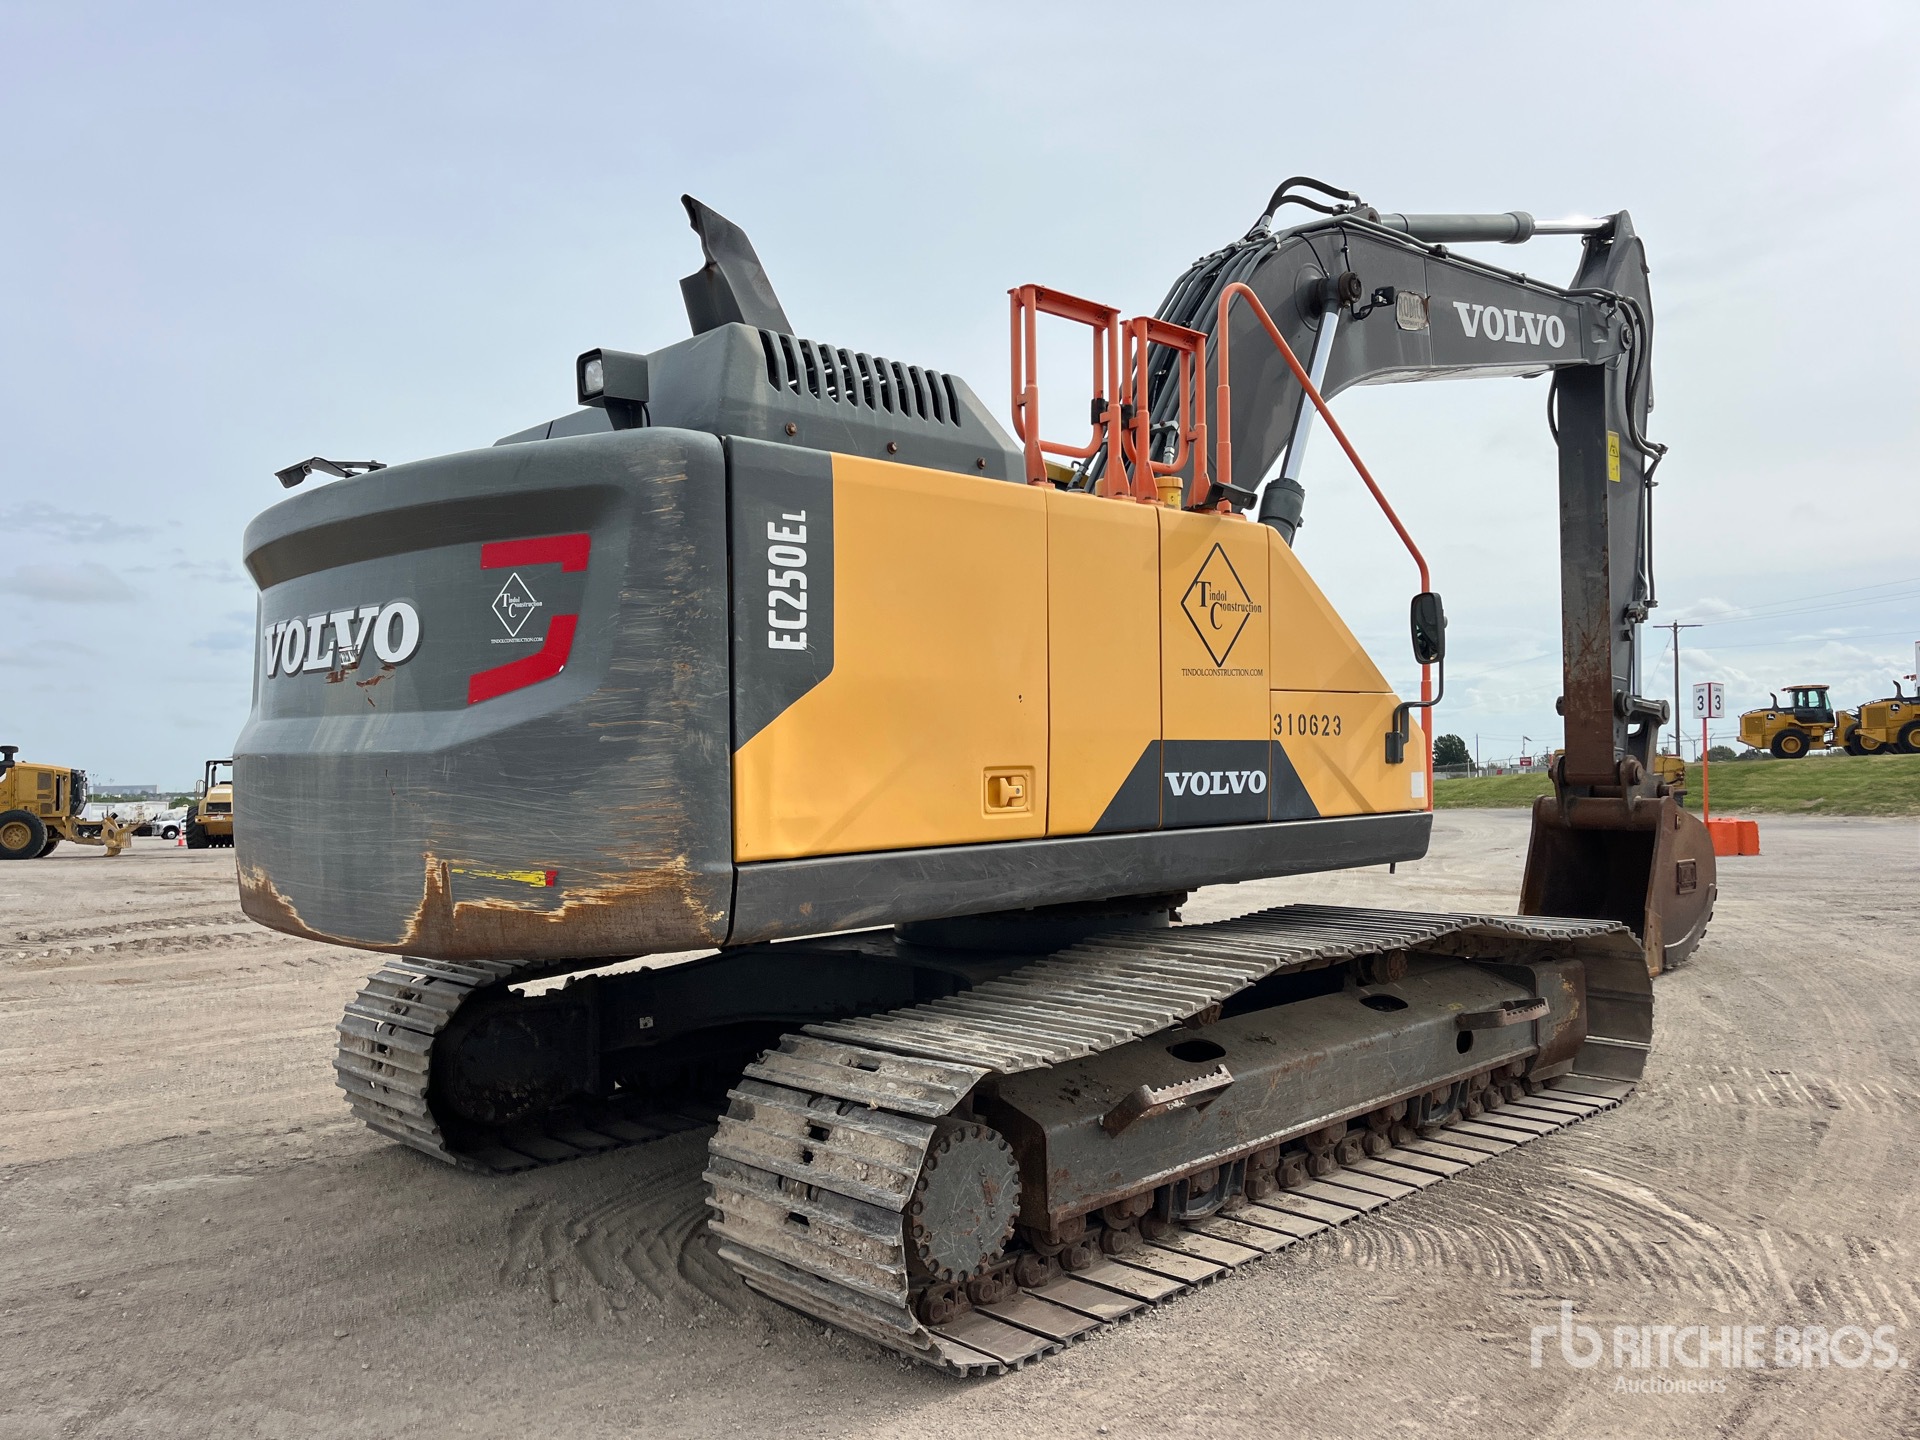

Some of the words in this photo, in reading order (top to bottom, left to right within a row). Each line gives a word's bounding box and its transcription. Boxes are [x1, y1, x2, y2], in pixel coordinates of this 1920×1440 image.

[1453, 301, 1566, 348] VOLVO
[1194, 580, 1227, 608] Tindol
[1209, 601, 1262, 630] Construction
[263, 601, 421, 679] VOLVO
[1181, 668, 1264, 677] TINDOLCONSTRUCTION.COM
[1697, 695, 1704, 710] 3
[1715, 695, 1721, 710] 3
[1273, 713, 1342, 736] 310623
[1164, 770, 1267, 796] VOLVO
